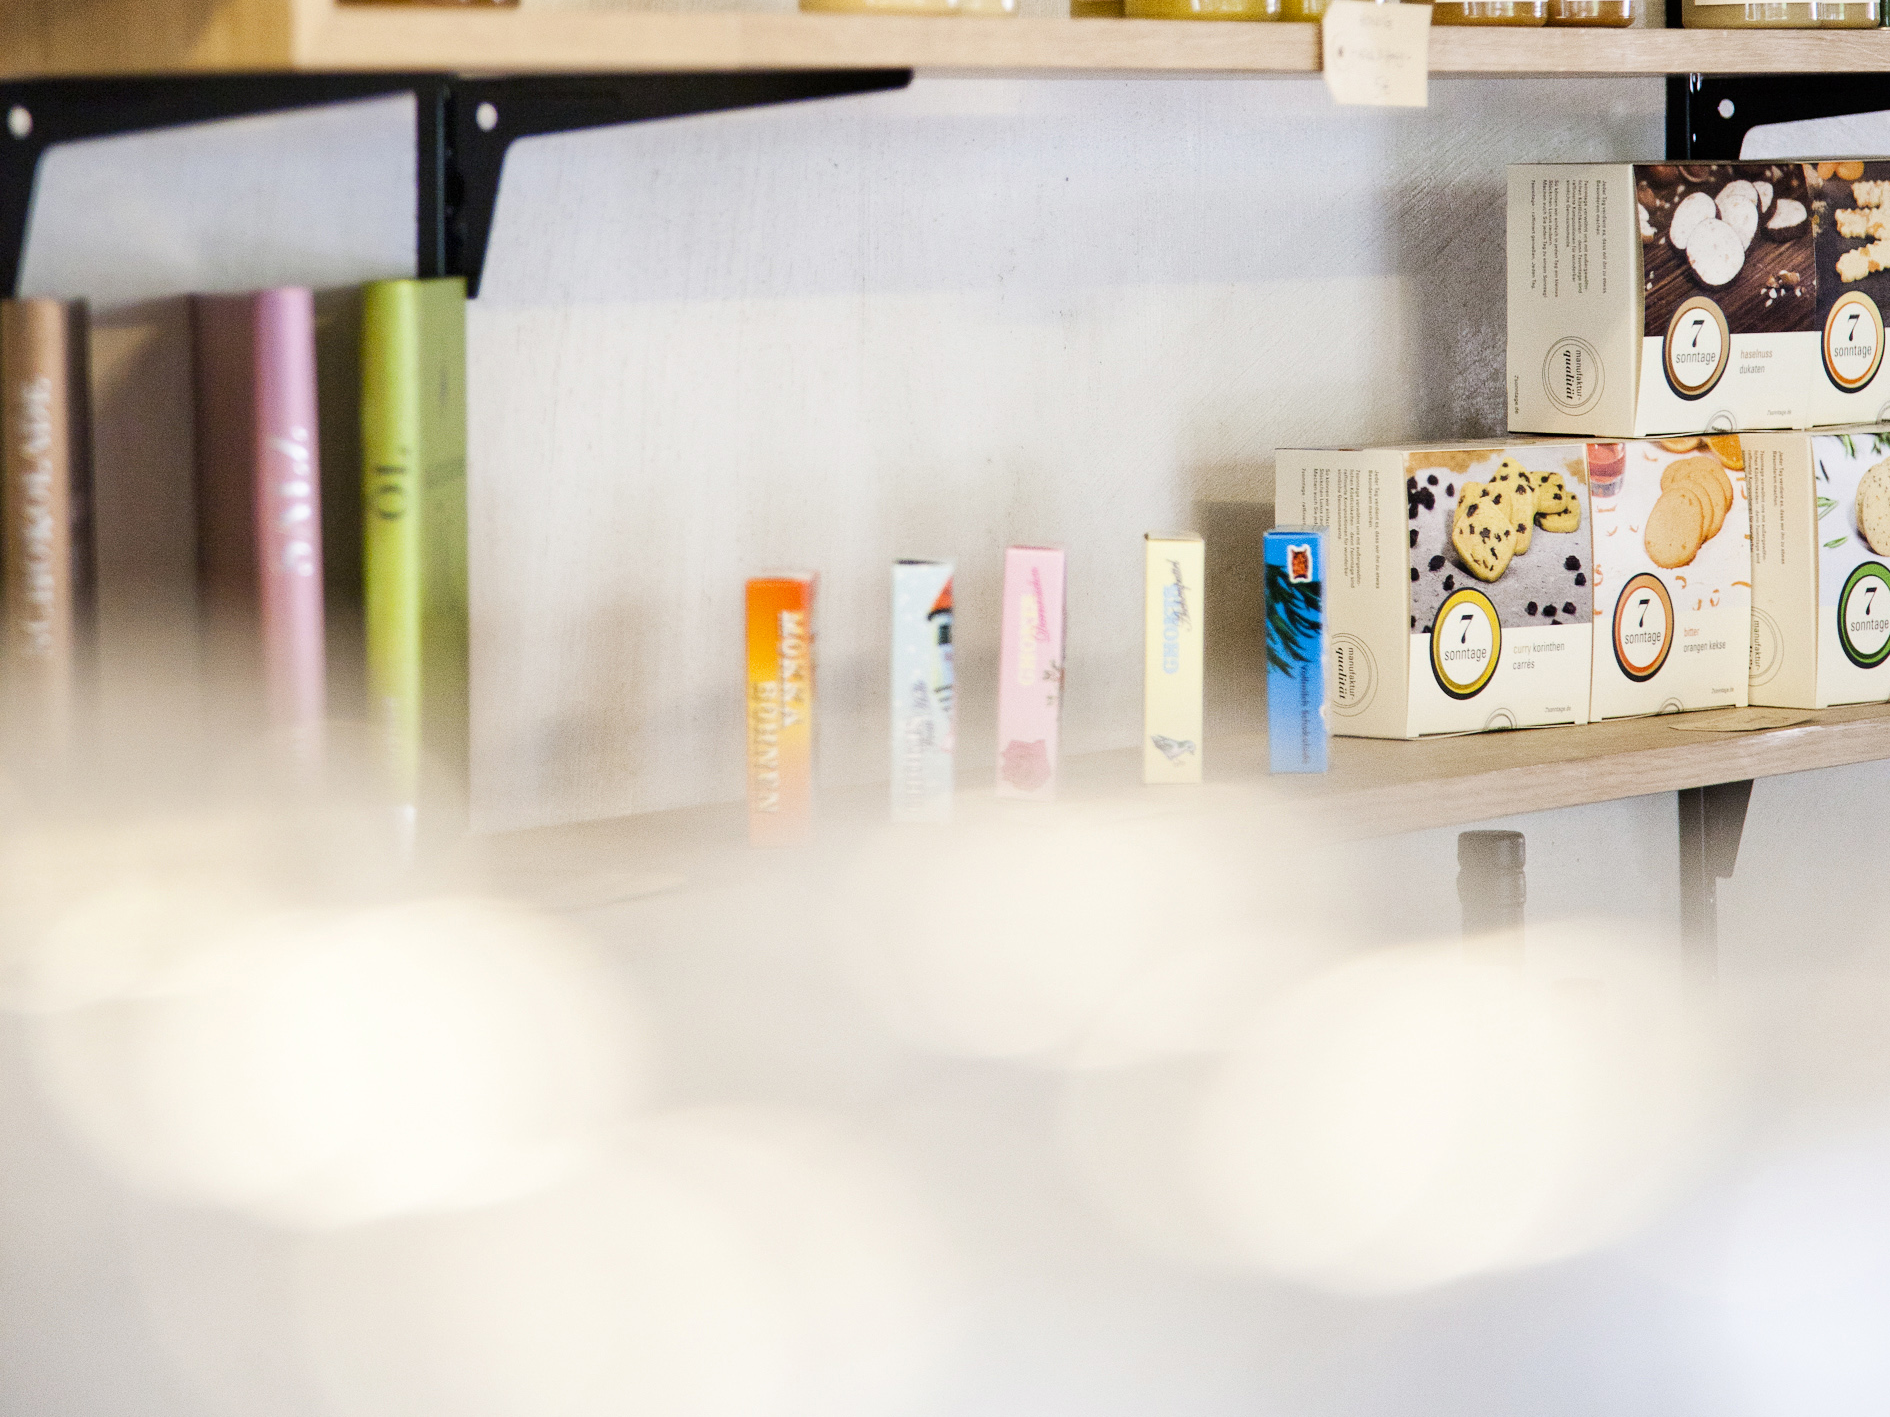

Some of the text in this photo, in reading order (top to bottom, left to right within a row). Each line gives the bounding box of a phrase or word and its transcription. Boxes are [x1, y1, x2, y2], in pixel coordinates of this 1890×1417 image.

[1690, 319, 1705, 348] 7
[1847, 313, 1861, 342] 7
[1675, 350, 1716, 366] sonntage
[1740, 349, 1773, 360] haselnuss
[1833, 343, 1872, 359] sonntage
[1563, 350, 1575, 400] qualität
[1575, 350, 1583, 401] manufaktur-
[1739, 364, 1766, 375] dukaten
[1864, 587, 1878, 616] 7
[1638, 598, 1651, 628] 7
[1459, 614, 1474, 644] 7
[1683, 627, 1700, 637] bitter
[1850, 619, 1890, 633] sonntage
[1624, 631, 1662, 646] sonntage
[1753, 620, 1762, 671] manufaktur-
[1444, 647, 1487, 663] sonntage
[1513, 641, 1565, 656] curry korinthen
[1683, 640, 1727, 654] orangen kekse
[1335, 647, 1347, 699] qualität
[1512, 659, 1536, 671] carrés
[1348, 647, 1357, 700] manufaktur-
